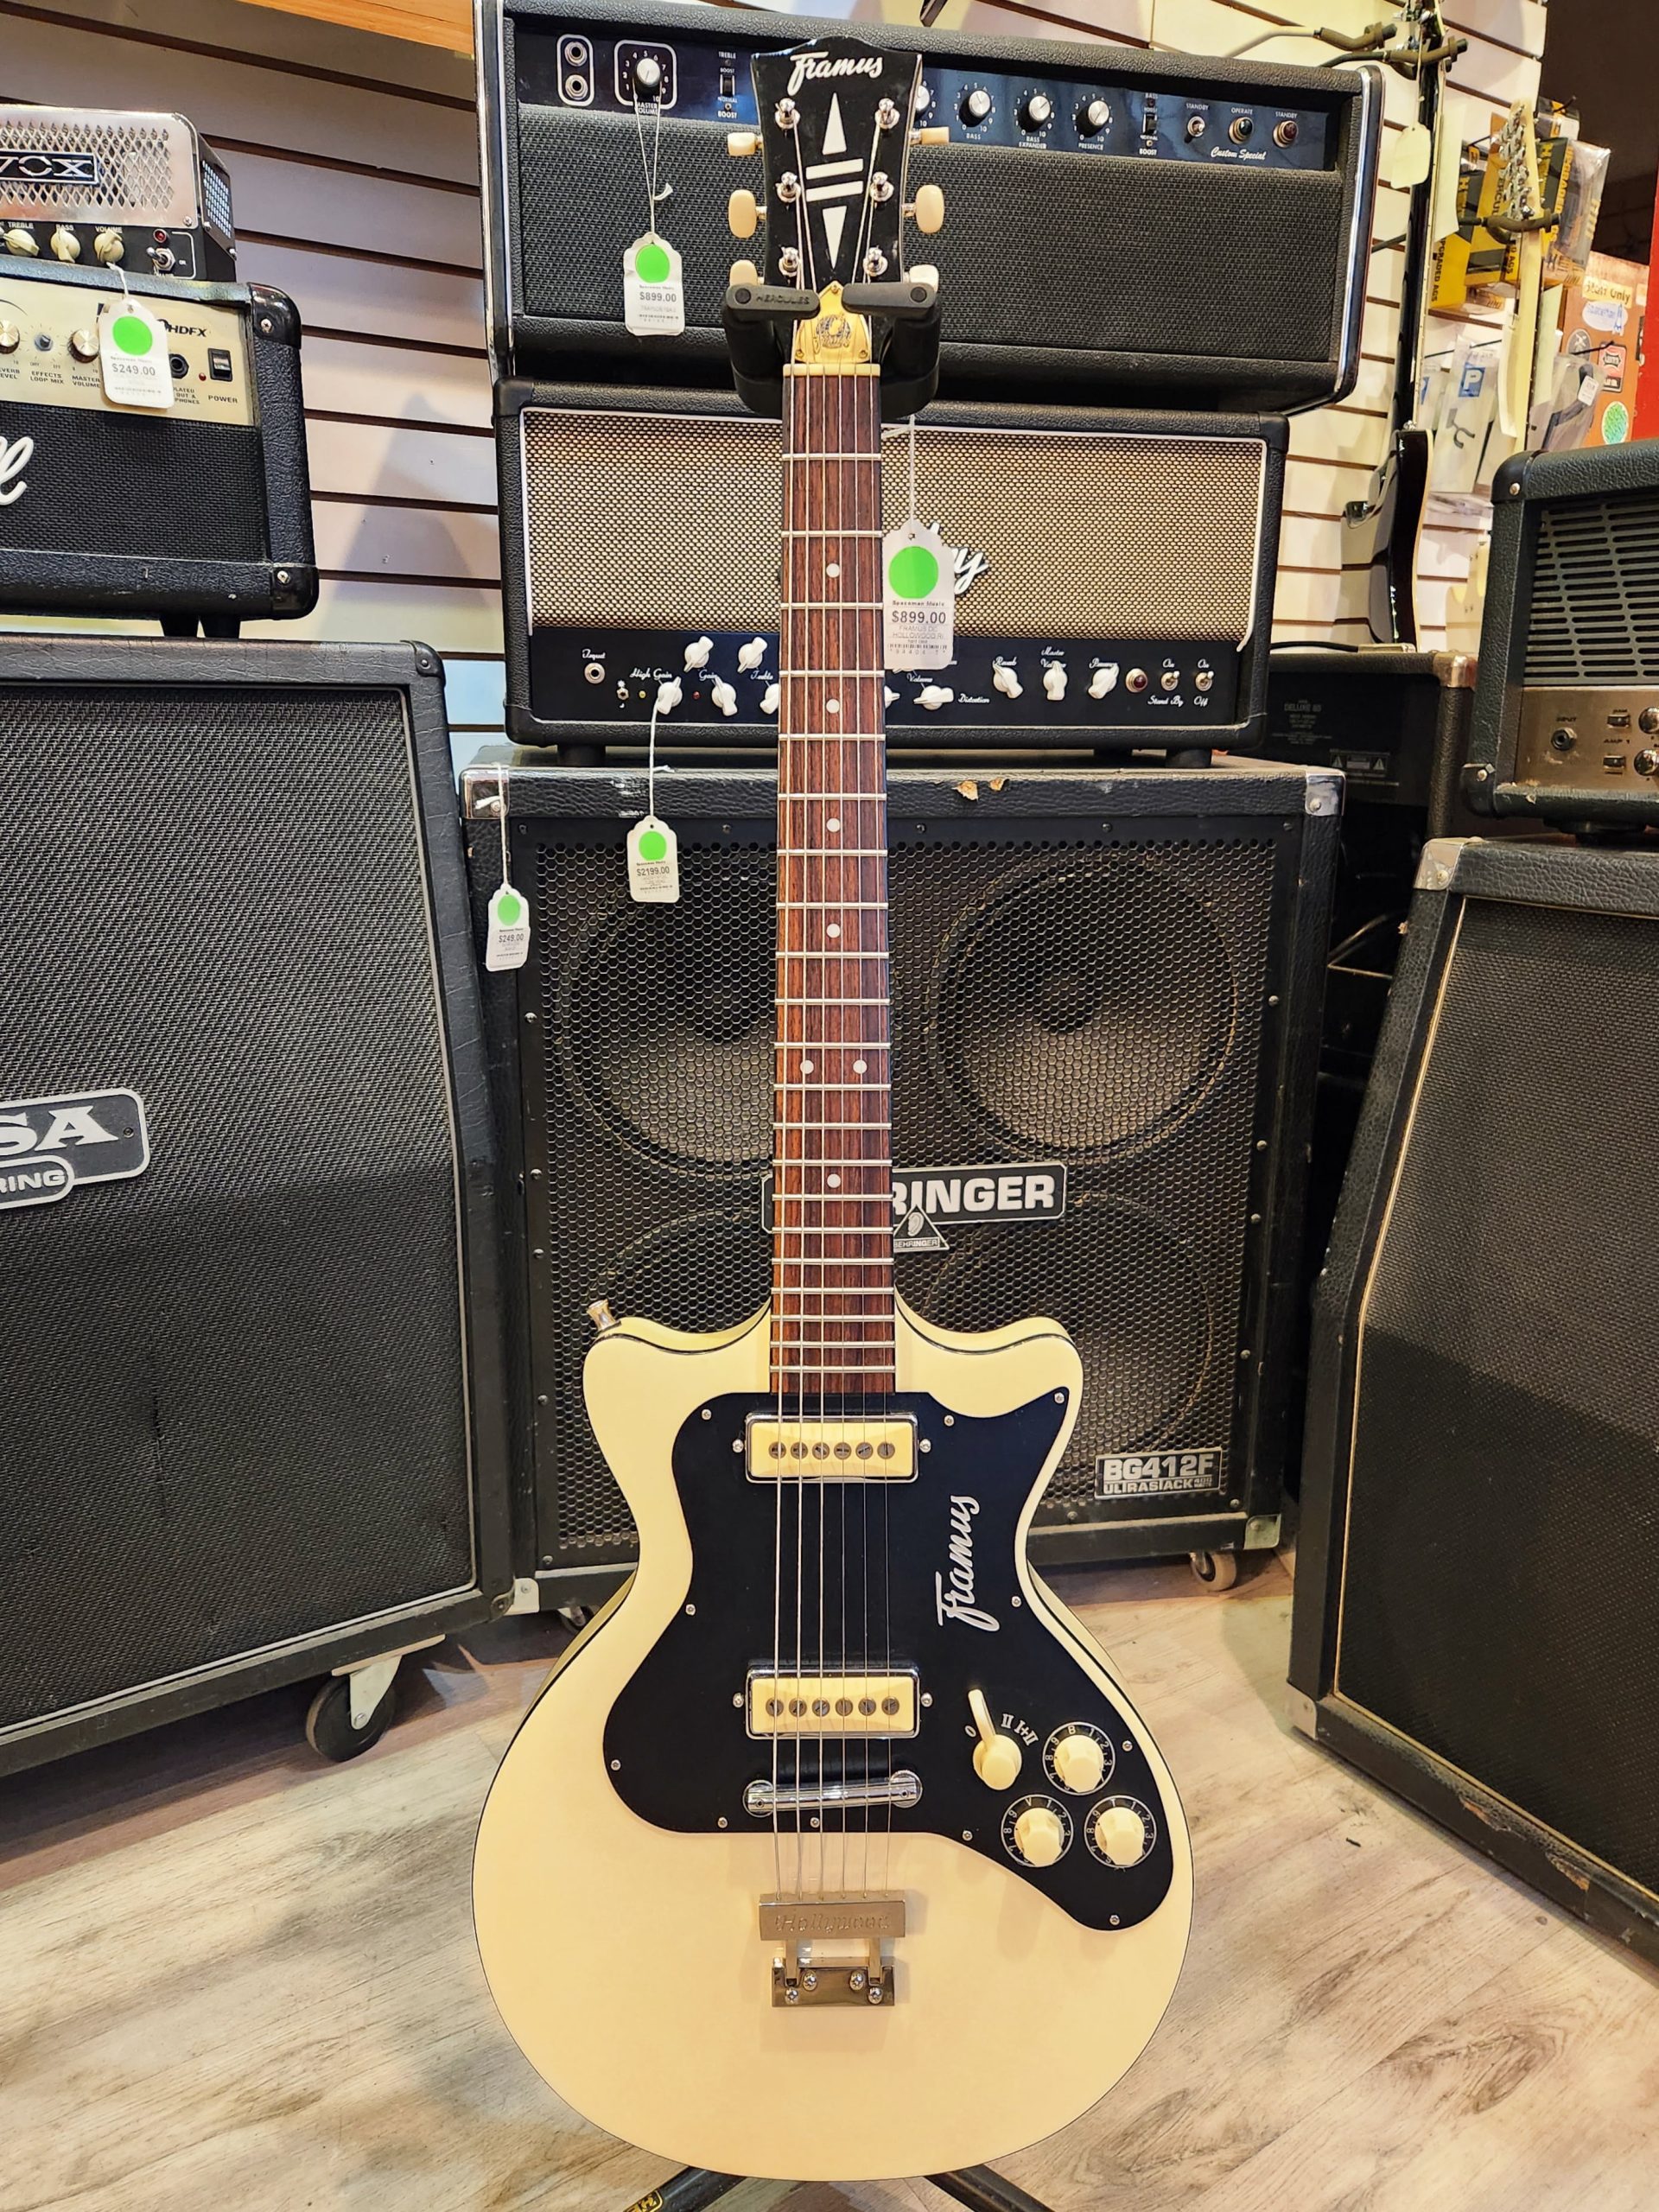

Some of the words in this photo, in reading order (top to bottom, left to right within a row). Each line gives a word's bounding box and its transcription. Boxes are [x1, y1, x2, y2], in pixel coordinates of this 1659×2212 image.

[787, 51, 883, 97] Framus
[1211, 146, 1237, 158] Custom
[1238, 149, 1267, 161] Special
[8, 221, 34, 230] TREBLE
[639, 290, 677, 302] $899.00
[1610, 286, 1631, 305] Only
[111, 363, 156, 377] $249.00
[208, 395, 238, 404] POWER
[892, 610, 946, 624] $899.00
[582, 648, 606, 661] Input
[1162, 658, 1175, 669] On
[1198, 658, 1210, 669] On
[629, 667, 651, 681] High
[653, 668, 672, 680] Gain
[1147, 695, 1169, 705] Stand
[1170, 695, 1184, 708] By
[1193, 696, 1209, 707] Off
[636, 866, 671, 876] $2199.00
[499, 933, 524, 944] $249.00
[893, 1239, 938, 1249] BEHRINGER
[1103, 1453, 1214, 1481] BG412F
[1103, 1478, 1193, 1495] ULTRASTACK
[935, 1495, 1001, 1632] Framus
[1001, 1713, 1014, 1729] II
[1068, 1725, 1076, 1734] B
[1089, 1728, 1095, 1737] 1
[1051, 1737, 1059, 1745] 9
[1025, 1797, 1032, 1806] V
[1110, 1798, 1116, 1807] T
[1131, 1801, 1136, 1809] 1
[1008, 1809, 1018, 1818] 9
[1092, 1809, 1101, 1818] 9
